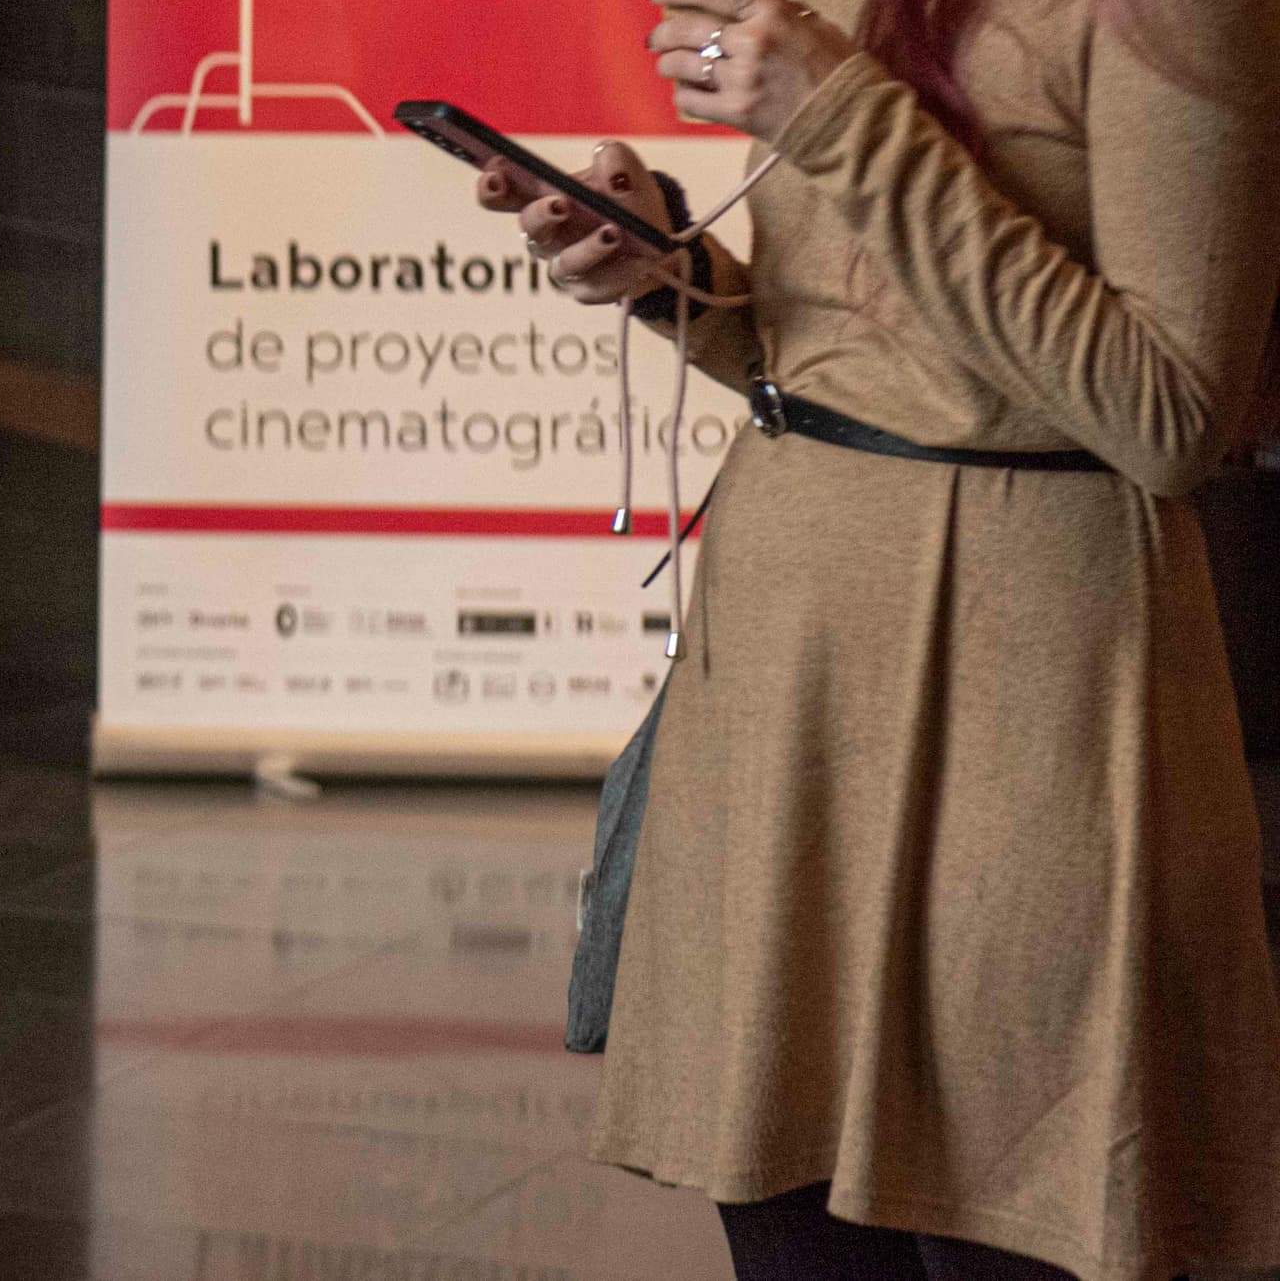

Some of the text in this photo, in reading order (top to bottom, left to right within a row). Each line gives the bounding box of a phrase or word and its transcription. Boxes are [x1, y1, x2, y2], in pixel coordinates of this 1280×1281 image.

[208, 239, 564, 292] Laboratori
[205, 320, 620, 385] de proyectos
[204, 398, 744, 470] cinematográfico
